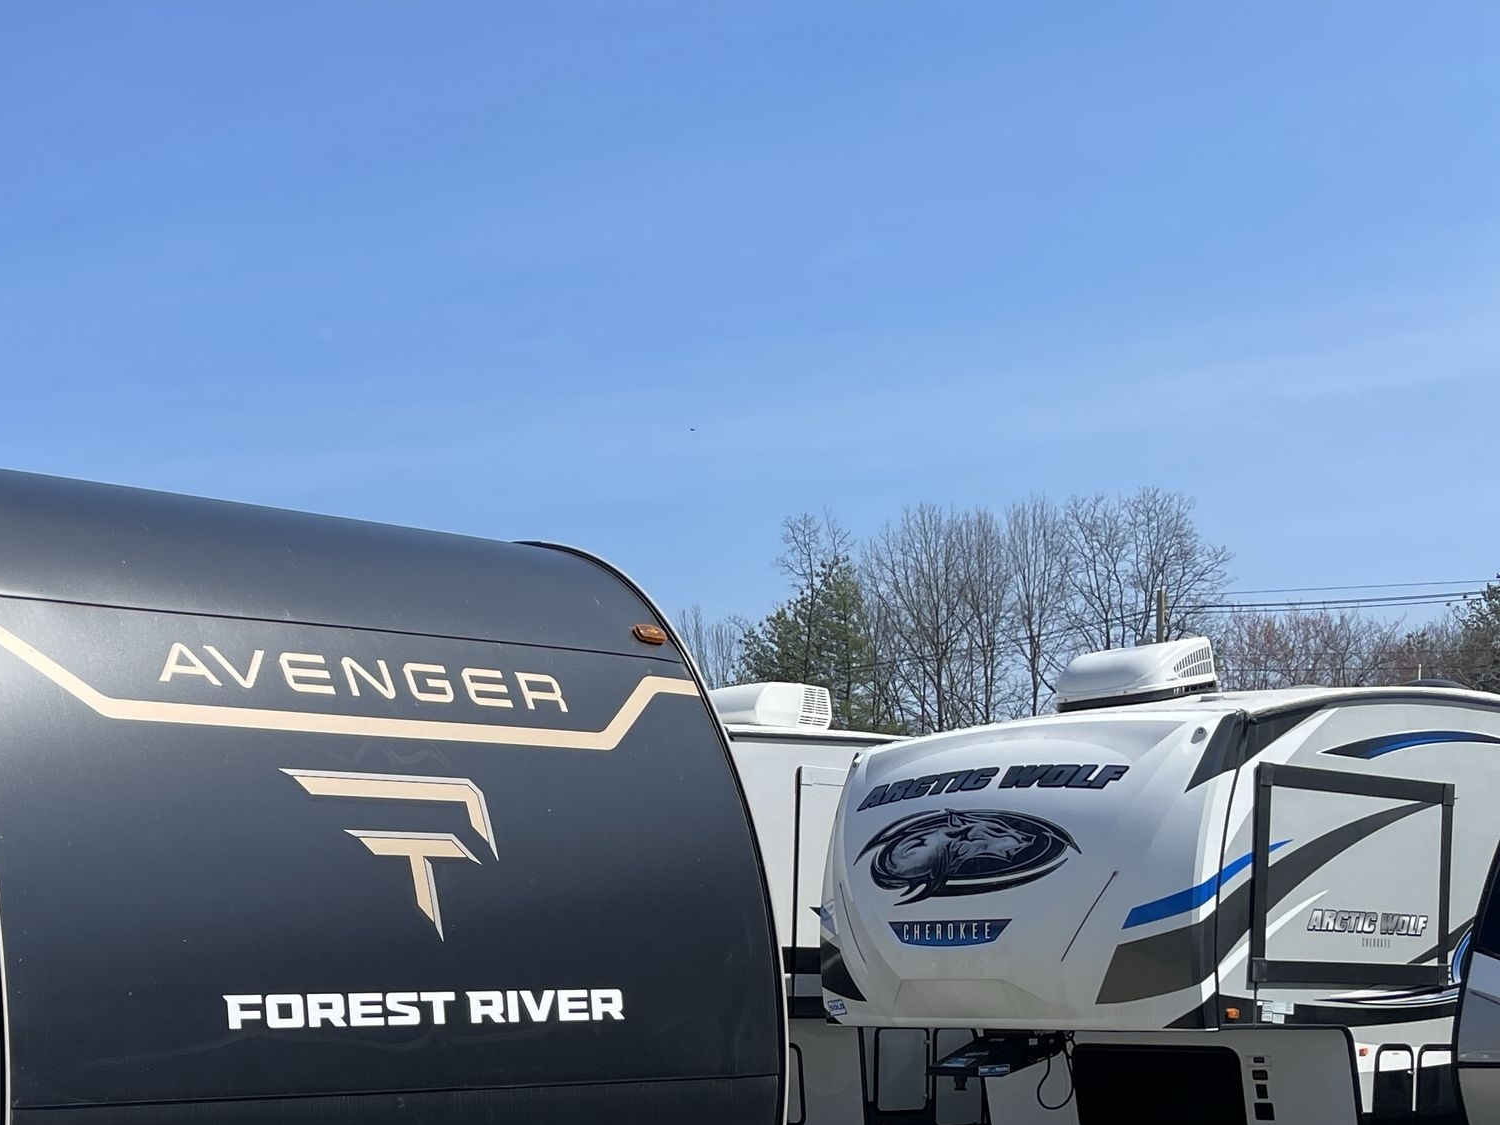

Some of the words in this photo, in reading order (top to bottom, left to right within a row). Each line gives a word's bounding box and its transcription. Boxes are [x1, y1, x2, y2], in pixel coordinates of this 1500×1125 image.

[159, 642, 569, 713] AVENGER
[857, 766, 1000, 812] ARCTIC
[997, 764, 1130, 789] WOLF
[903, 922, 992, 940] CHEROKEE
[1307, 908, 1378, 934] ARCTIC
[1380, 912, 1428, 937] WOLF
[1361, 938, 1391, 949] CHEROKEE
[222, 991, 455, 1031] FOREST
[465, 988, 625, 1024] RIVER
